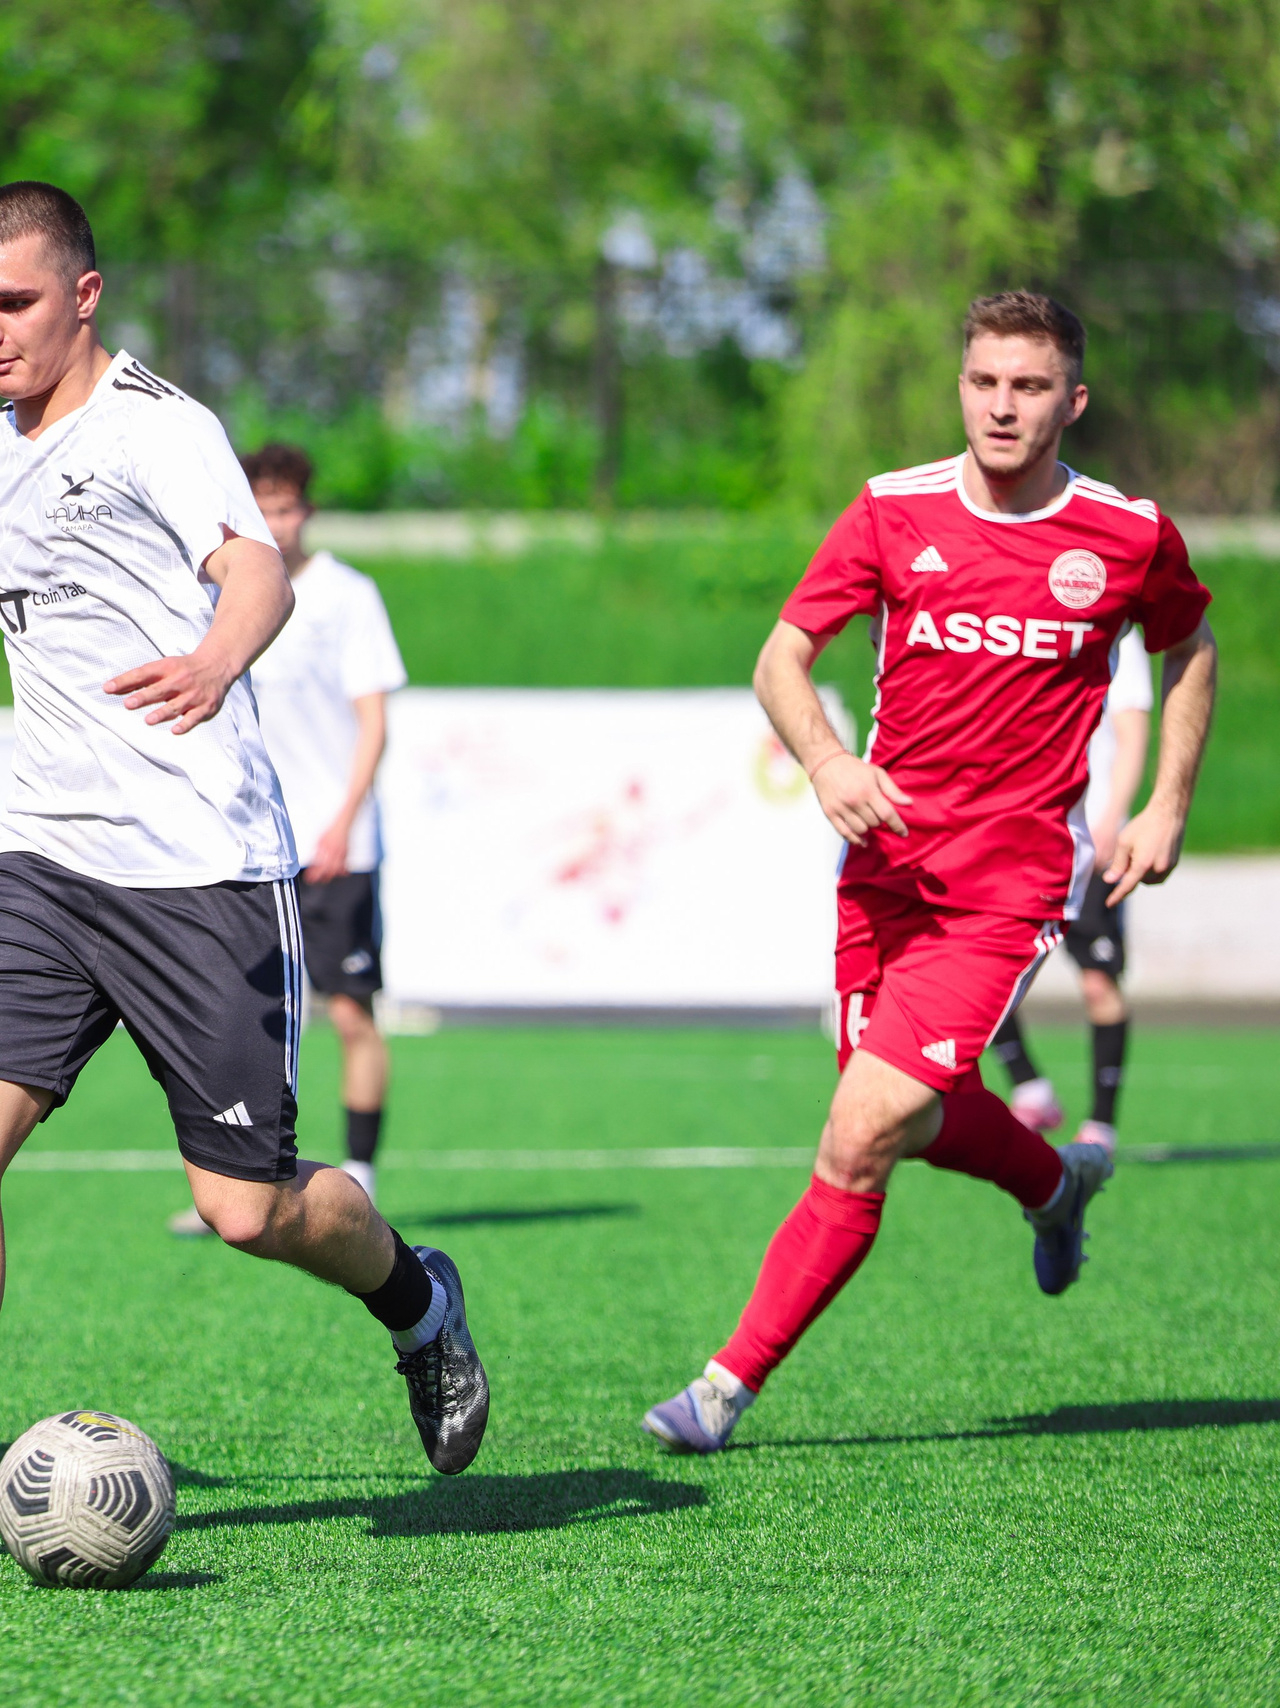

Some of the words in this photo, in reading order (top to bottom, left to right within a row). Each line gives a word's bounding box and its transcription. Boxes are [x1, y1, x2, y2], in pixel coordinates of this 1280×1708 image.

[45, 502, 113, 524] ЧАЙКА
[61, 524, 94, 532] САМАРА
[32, 588, 62, 606] Coin
[58, 581, 87, 599] Tab
[906, 610, 1095, 660] ASSET
